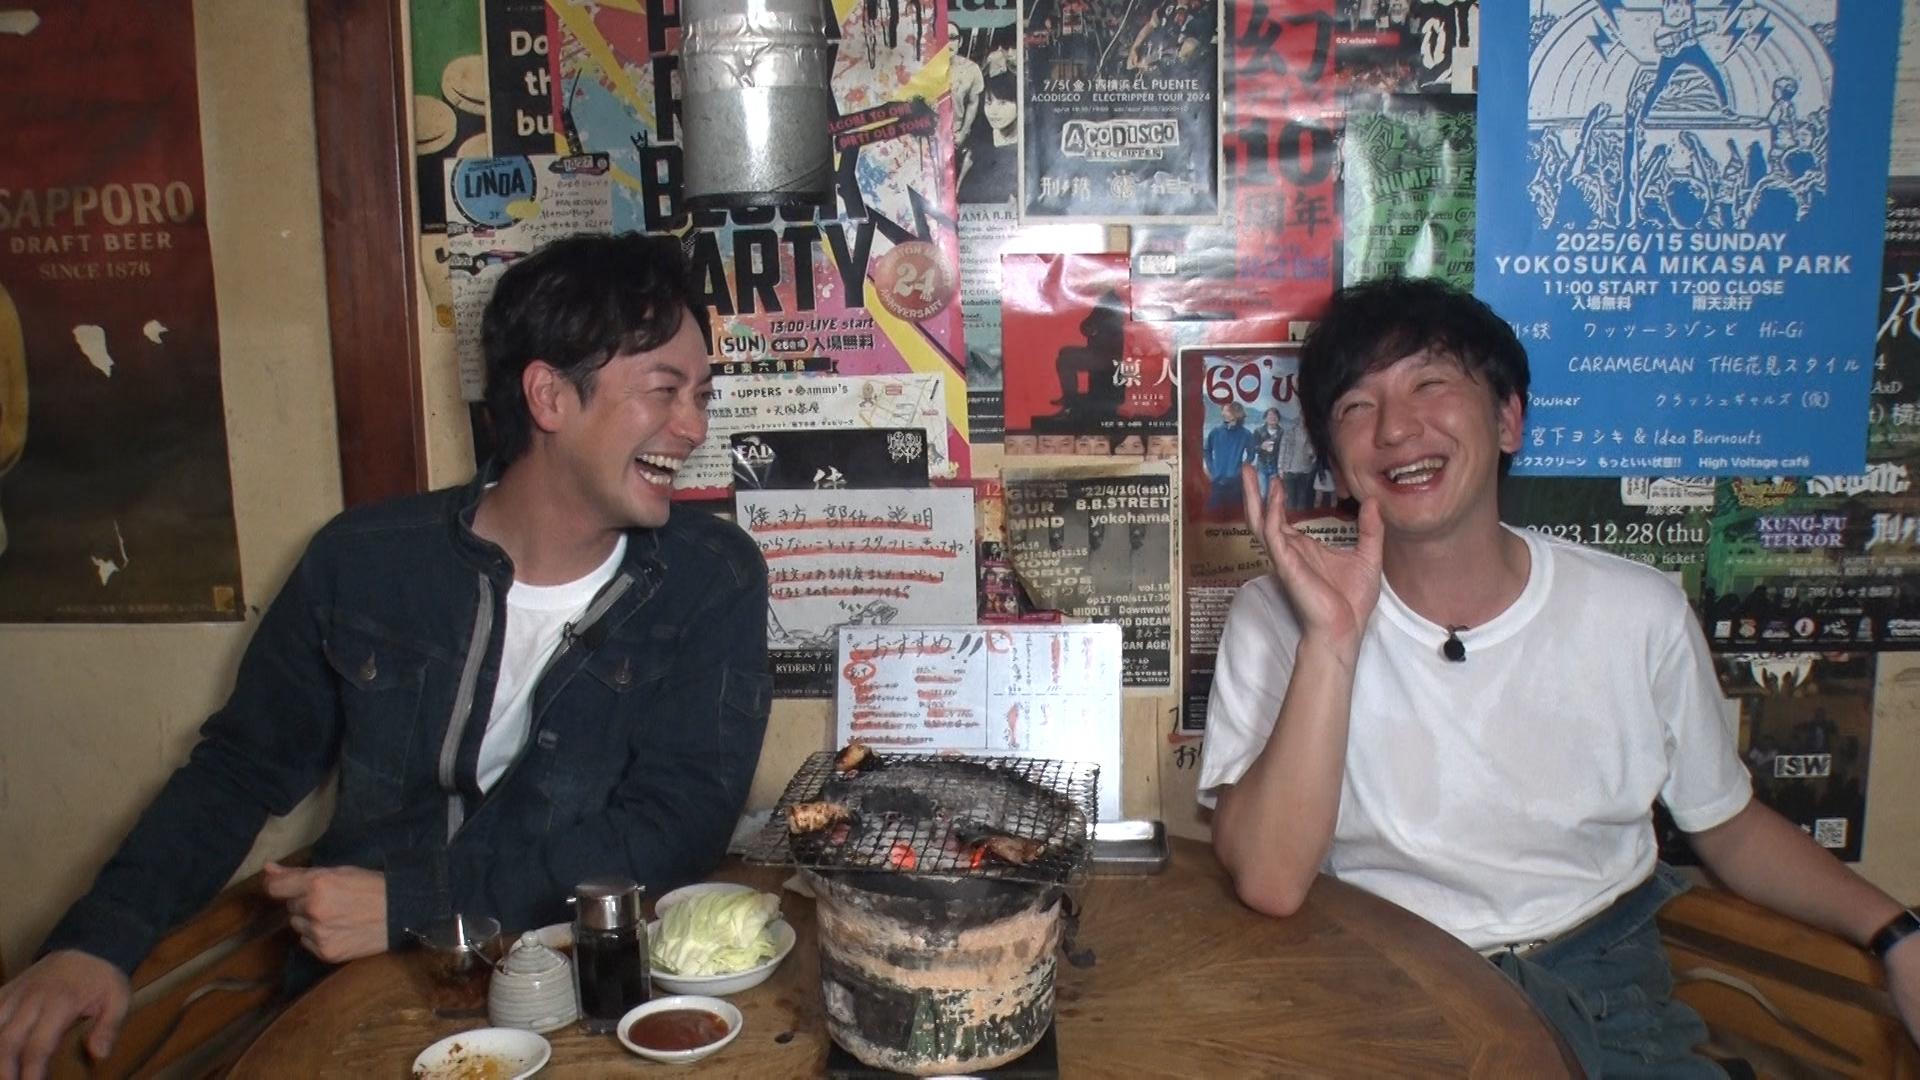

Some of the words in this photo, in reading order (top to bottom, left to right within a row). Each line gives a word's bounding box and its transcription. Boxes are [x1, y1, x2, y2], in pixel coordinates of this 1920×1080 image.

[1133, 79, 1147, 90] EL
[1152, 79, 1199, 90] PUENTE
[1031, 93, 1081, 102] ACODISCO
[1093, 93, 1154, 102] ELECTRIPPER
[1158, 92, 1183, 101] TOUR
[1187, 92, 1211, 101] 2024
[1064, 122, 1177, 151] ACODISCO
[464, 168, 526, 199] LINDA
[0, 181, 195, 231] SAPPORO
[10, 234, 92, 255] DRAFT
[103, 231, 173, 252] BEER
[1555, 233, 1683, 253] 2025/6/15
[1689, 233, 1787, 252] SUNDAY
[40, 262, 99, 281] SINCE
[695, 224, 876, 317] ARTY
[1495, 255, 1648, 276] YOKOSUKA
[1659, 255, 1766, 275] MIKASA
[1776, 255, 1852, 275] PARK
[1543, 280, 1593, 295] 11:00
[1598, 280, 1659, 295] START
[1670, 280, 1719, 295] 17:00
[1725, 280, 1785, 295] CLOSE
[1571, 296, 1632, 311] 入場無料
[1760, 320, 1804, 339] Hi-Gi
[718, 335, 766, 353] (SUN)
[1568, 356, 1694, 374] CARAMELMAN
[1708, 355, 1860, 376] THE花見スタイル
[738, 387, 782, 399] UPPERS
[1530, 428, 1623, 447] 宮下ヨシキ
[1633, 428, 1647, 446] &
[1653, 429, 1686, 446] Idea
[1692, 428, 1762, 446] Burnouts
[1698, 456, 1728, 470] High
[1730, 456, 1779, 470] Voltage
[1780, 455, 1810, 468] café
[1010, 501, 1054, 514] OUR
[1075, 496, 1170, 510] B.B.STREET
[1010, 517, 1065, 530] MIND
[1090, 512, 1170, 528] yokohama
[1759, 516, 1847, 532] KUNG-FU
[1762, 532, 1843, 547] TERROR
[1662, 552, 1694, 565] ticket
[1135, 617, 1170, 627] DREAM
